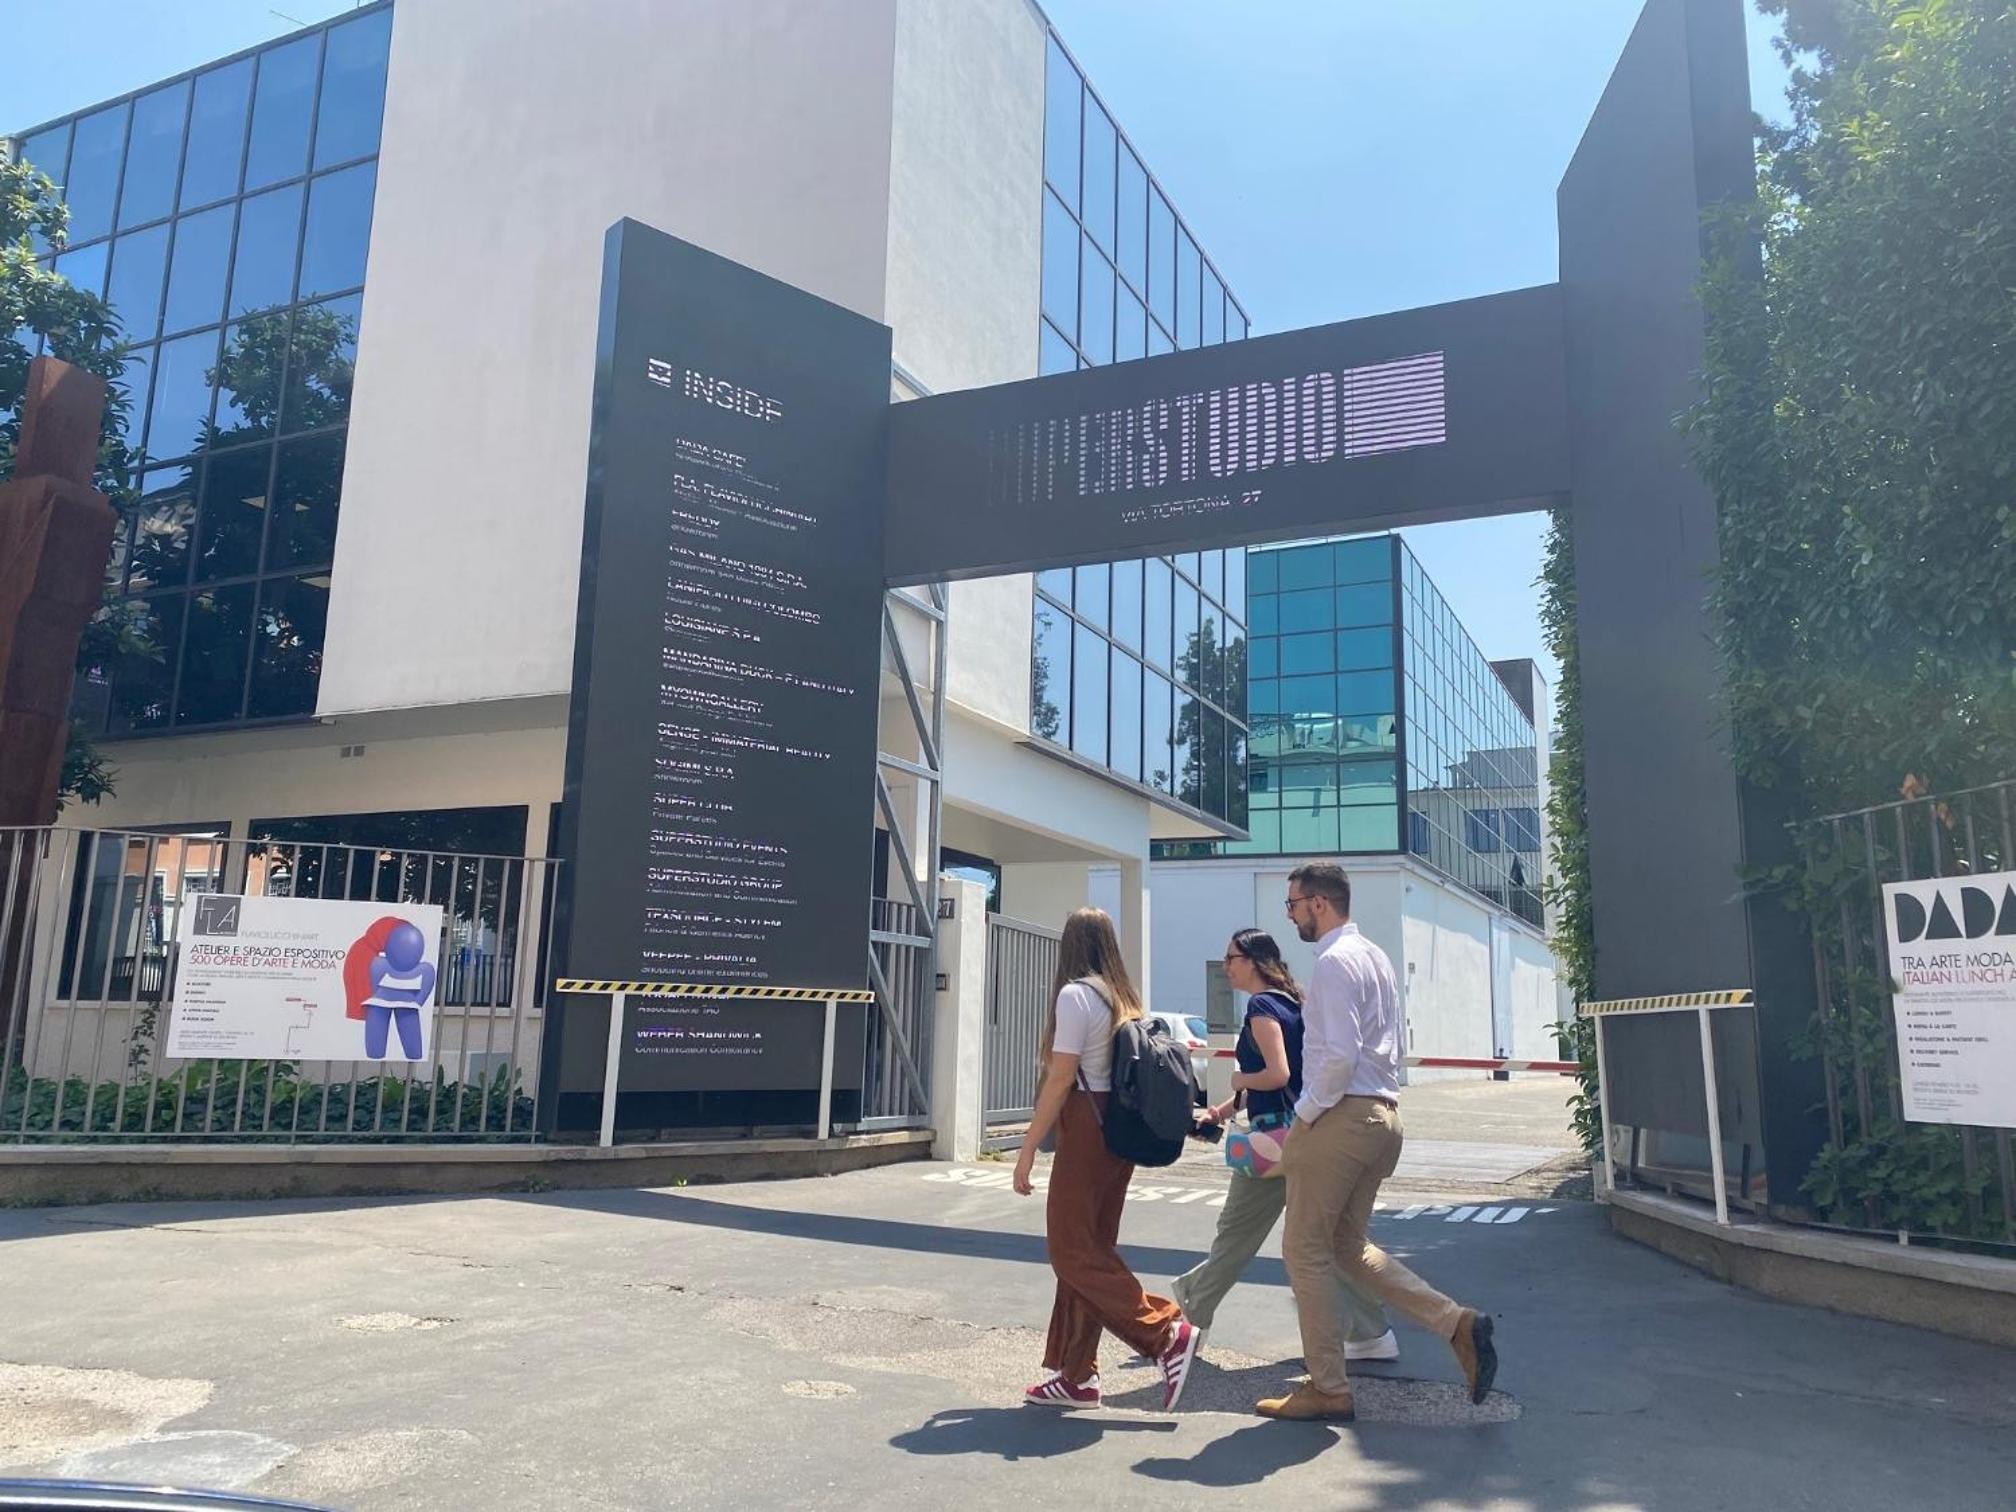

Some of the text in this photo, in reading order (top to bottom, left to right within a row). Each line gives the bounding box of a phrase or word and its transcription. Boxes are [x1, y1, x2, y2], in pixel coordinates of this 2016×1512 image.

[190, 944, 346, 960] ATELIER E SPAZIO ESPOSITIVO
[1901, 951, 2013, 970] TRA ARTE MODA
[190, 954, 211, 966] 500
[213, 955, 249, 967] OPERE
[292, 957, 299, 968] E
[301, 958, 337, 970] MODA
[1903, 970, 1952, 985] ITALIAN
[1955, 967, 2005, 984] LUNCH
